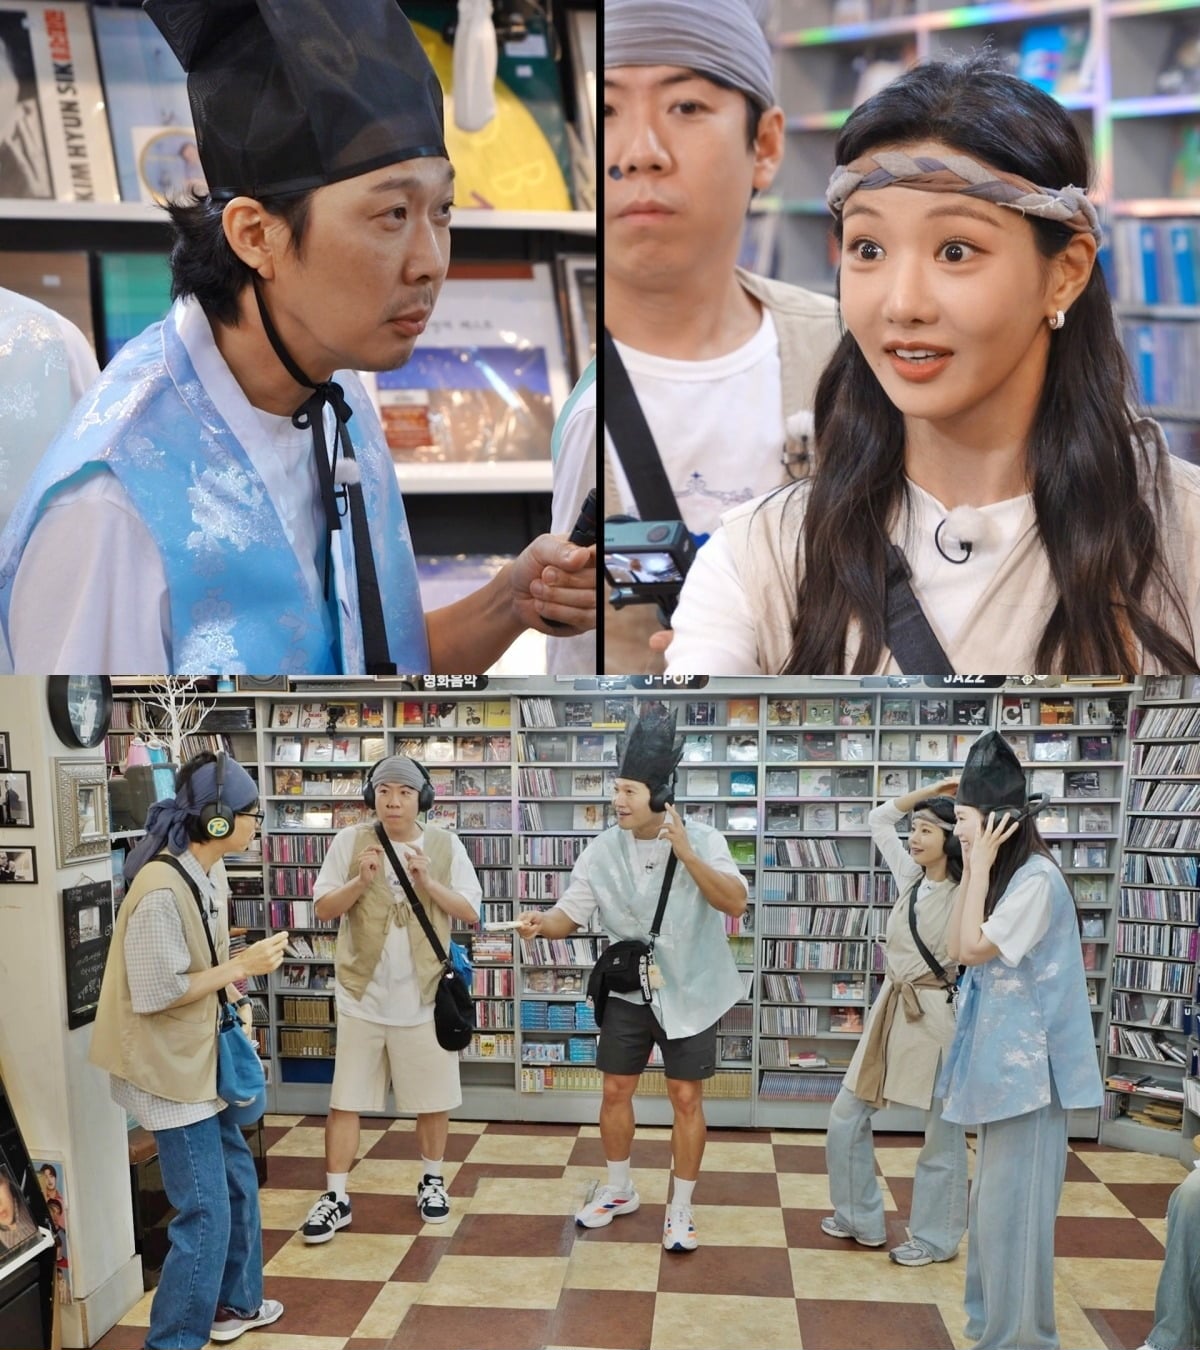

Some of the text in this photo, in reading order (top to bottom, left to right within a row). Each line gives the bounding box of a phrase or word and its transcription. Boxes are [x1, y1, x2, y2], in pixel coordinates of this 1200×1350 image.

[53, 62, 78, 96] SIK
[59, 100, 87, 158] HYUN
[70, 162, 96, 201] KIM
[644, 674, 695, 686] J-POP
[943, 674, 986, 684] JAZZ
